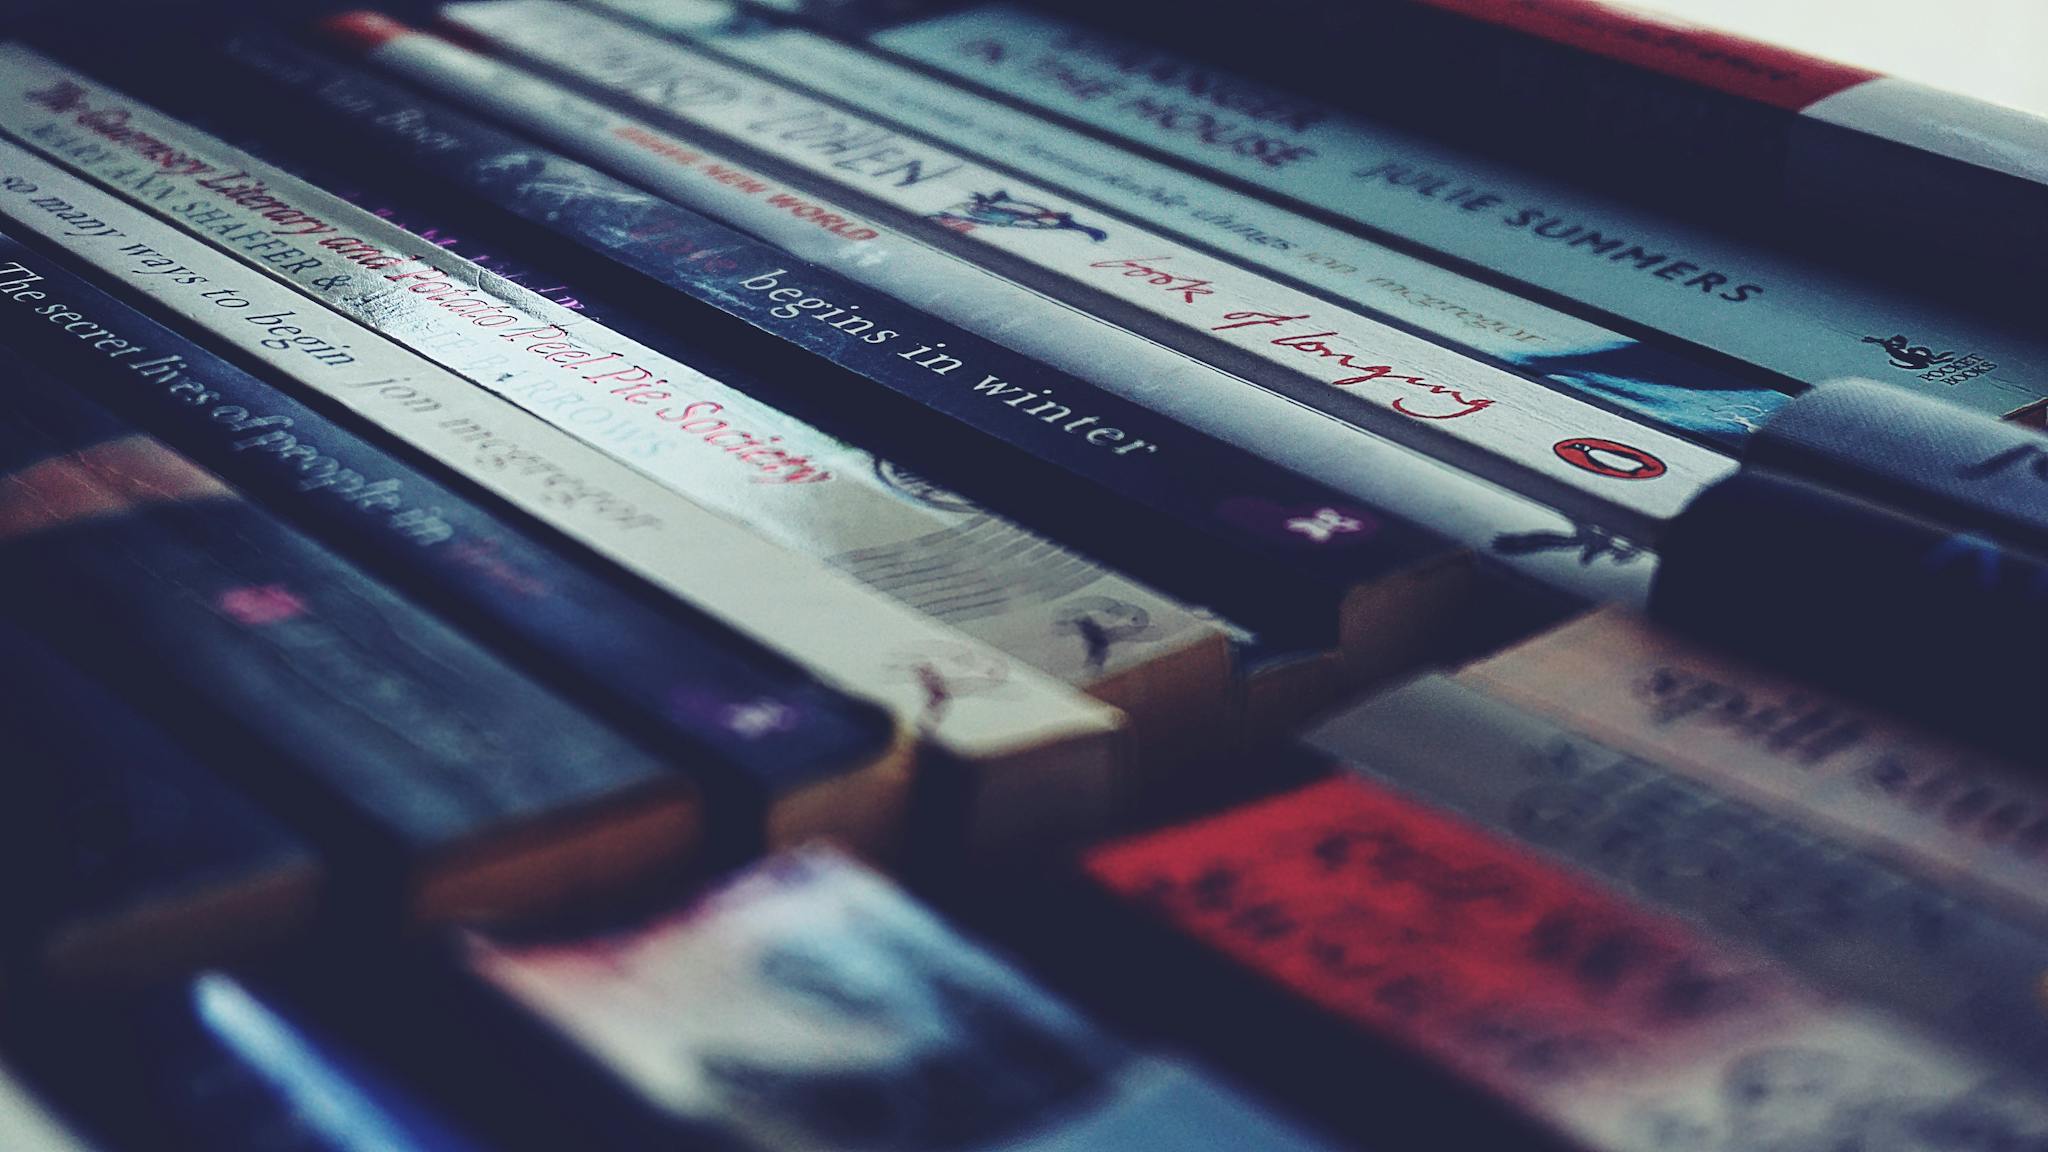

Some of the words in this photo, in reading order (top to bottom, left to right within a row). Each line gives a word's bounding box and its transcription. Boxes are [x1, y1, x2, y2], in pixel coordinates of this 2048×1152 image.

[172, 200, 323, 275] SHAFFER
[310, 273, 352, 291] &
[702, 163, 768, 193] NEW
[766, 193, 880, 241] WORLD
[1350, 163, 1502, 212] JULIE
[1503, 207, 1765, 303] SUMMERS
[0, 261, 47, 302] The
[34, 303, 146, 358] secret
[127, 354, 221, 406] lives
[210, 404, 294, 432] of
[2, 176, 38, 194] so
[28, 196, 127, 238] many
[118, 242, 210, 286] ways
[200, 288, 250, 309] to
[245, 310, 356, 367] begin
[345, 376, 443, 412] jon
[195, 169, 339, 235] Literary
[317, 236, 425, 270] and
[384, 265, 519, 327] Potato
[498, 323, 625, 370] Peel
[582, 365, 672, 404] Pie
[656, 400, 833, 485] Society
[739, 268, 899, 345] begins
[897, 342, 963, 376] in
[973, 373, 1159, 456] winter
[1088, 255, 1215, 304] book
[1270, 331, 1497, 420] longing
[1916, 352, 1986, 382] POCKET
[1938, 361, 1999, 386] BOOKS
